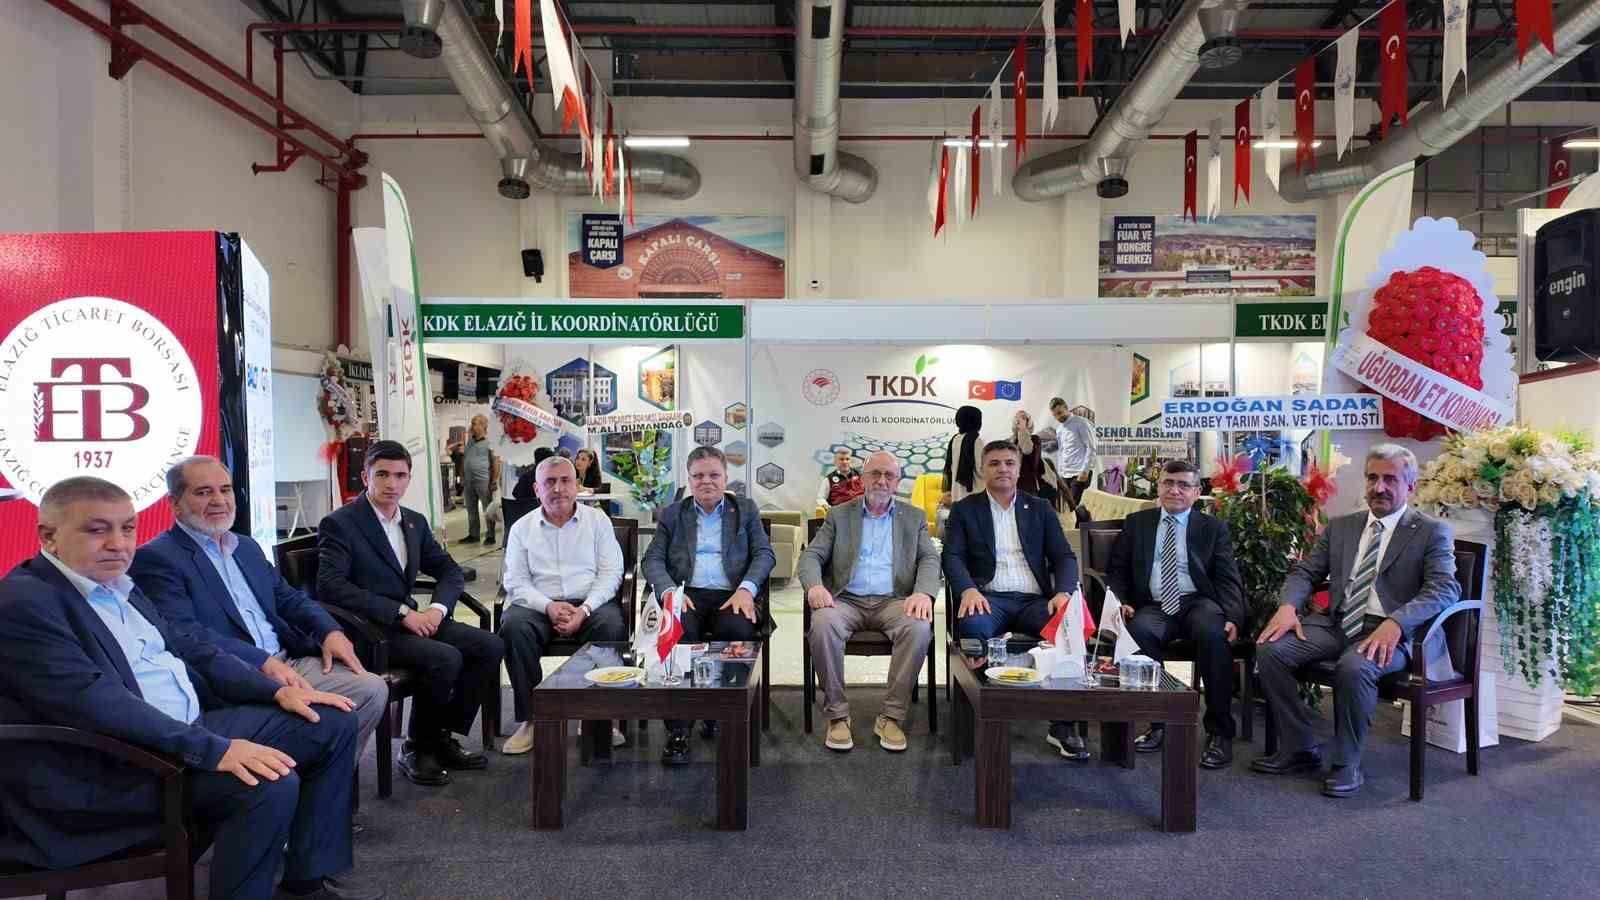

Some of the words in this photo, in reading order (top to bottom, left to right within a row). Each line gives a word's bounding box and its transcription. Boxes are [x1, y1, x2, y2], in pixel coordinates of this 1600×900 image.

[588, 238, 618, 249] KAPALI
[1117, 231, 1140, 240] FUAR
[1142, 231, 1152, 240] VE
[638, 234, 681, 266] KAPALI
[1117, 242, 1152, 252] KONGRE
[590, 250, 616, 264] ÇARŞI
[1549, 271, 1586, 295] engin
[423, 315, 460, 331] KDK
[463, 311, 527, 331] ELAZIĞ
[530, 311, 548, 331] İL
[550, 311, 720, 332] KOORDİNATÖRLÜĞÜ
[1258, 313, 1308, 330] TKDK
[41, 307, 126, 331] TİCARET
[131, 319, 190, 392] BORSASI
[866, 376, 937, 397] TKDK
[1357, 349, 1428, 406] UĞURDAN
[1418, 383, 1448, 418] ET
[1164, 398, 1283, 414] ERDOĞAN
[1292, 398, 1378, 412] SADAK
[882, 414, 957, 425] KOORDİNATÖRLÜ
[1165, 415, 1223, 429] SADAKBEY
[1226, 414, 1260, 428] TARIM
[1263, 414, 1289, 427] SAN.
[1293, 414, 1307, 427] VE
[1311, 412, 1333, 426] TİC.
[74, 451, 113, 469] 1937
